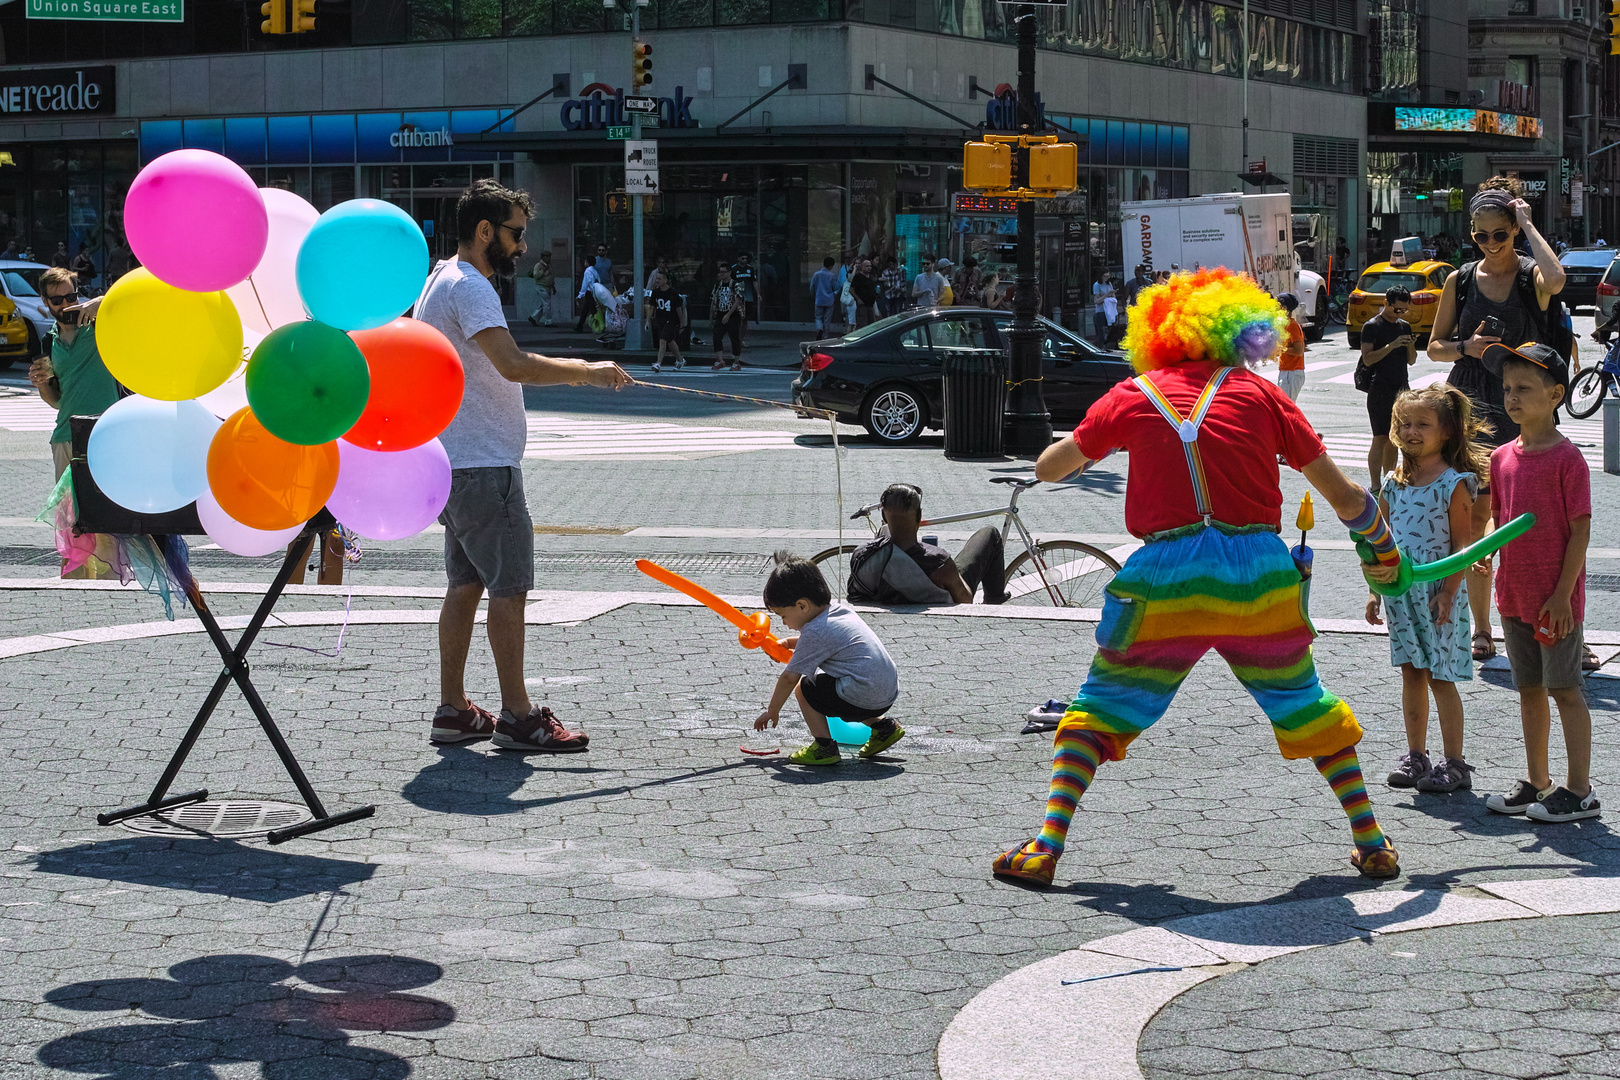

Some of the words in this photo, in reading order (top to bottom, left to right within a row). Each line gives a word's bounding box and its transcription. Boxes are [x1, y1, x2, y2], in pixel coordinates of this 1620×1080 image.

[33, 0, 79, 12] Union
[83, 2, 138, 15] Square
[142, 3, 177, 14] East
[629, 100, 639, 108] ONE
[643, 101, 653, 109] WAY
[389, 126, 453, 147] citibank
[609, 128, 614, 138] E
[615, 128, 624, 138] 14
[1561, 157, 1570, 195] zumiez
